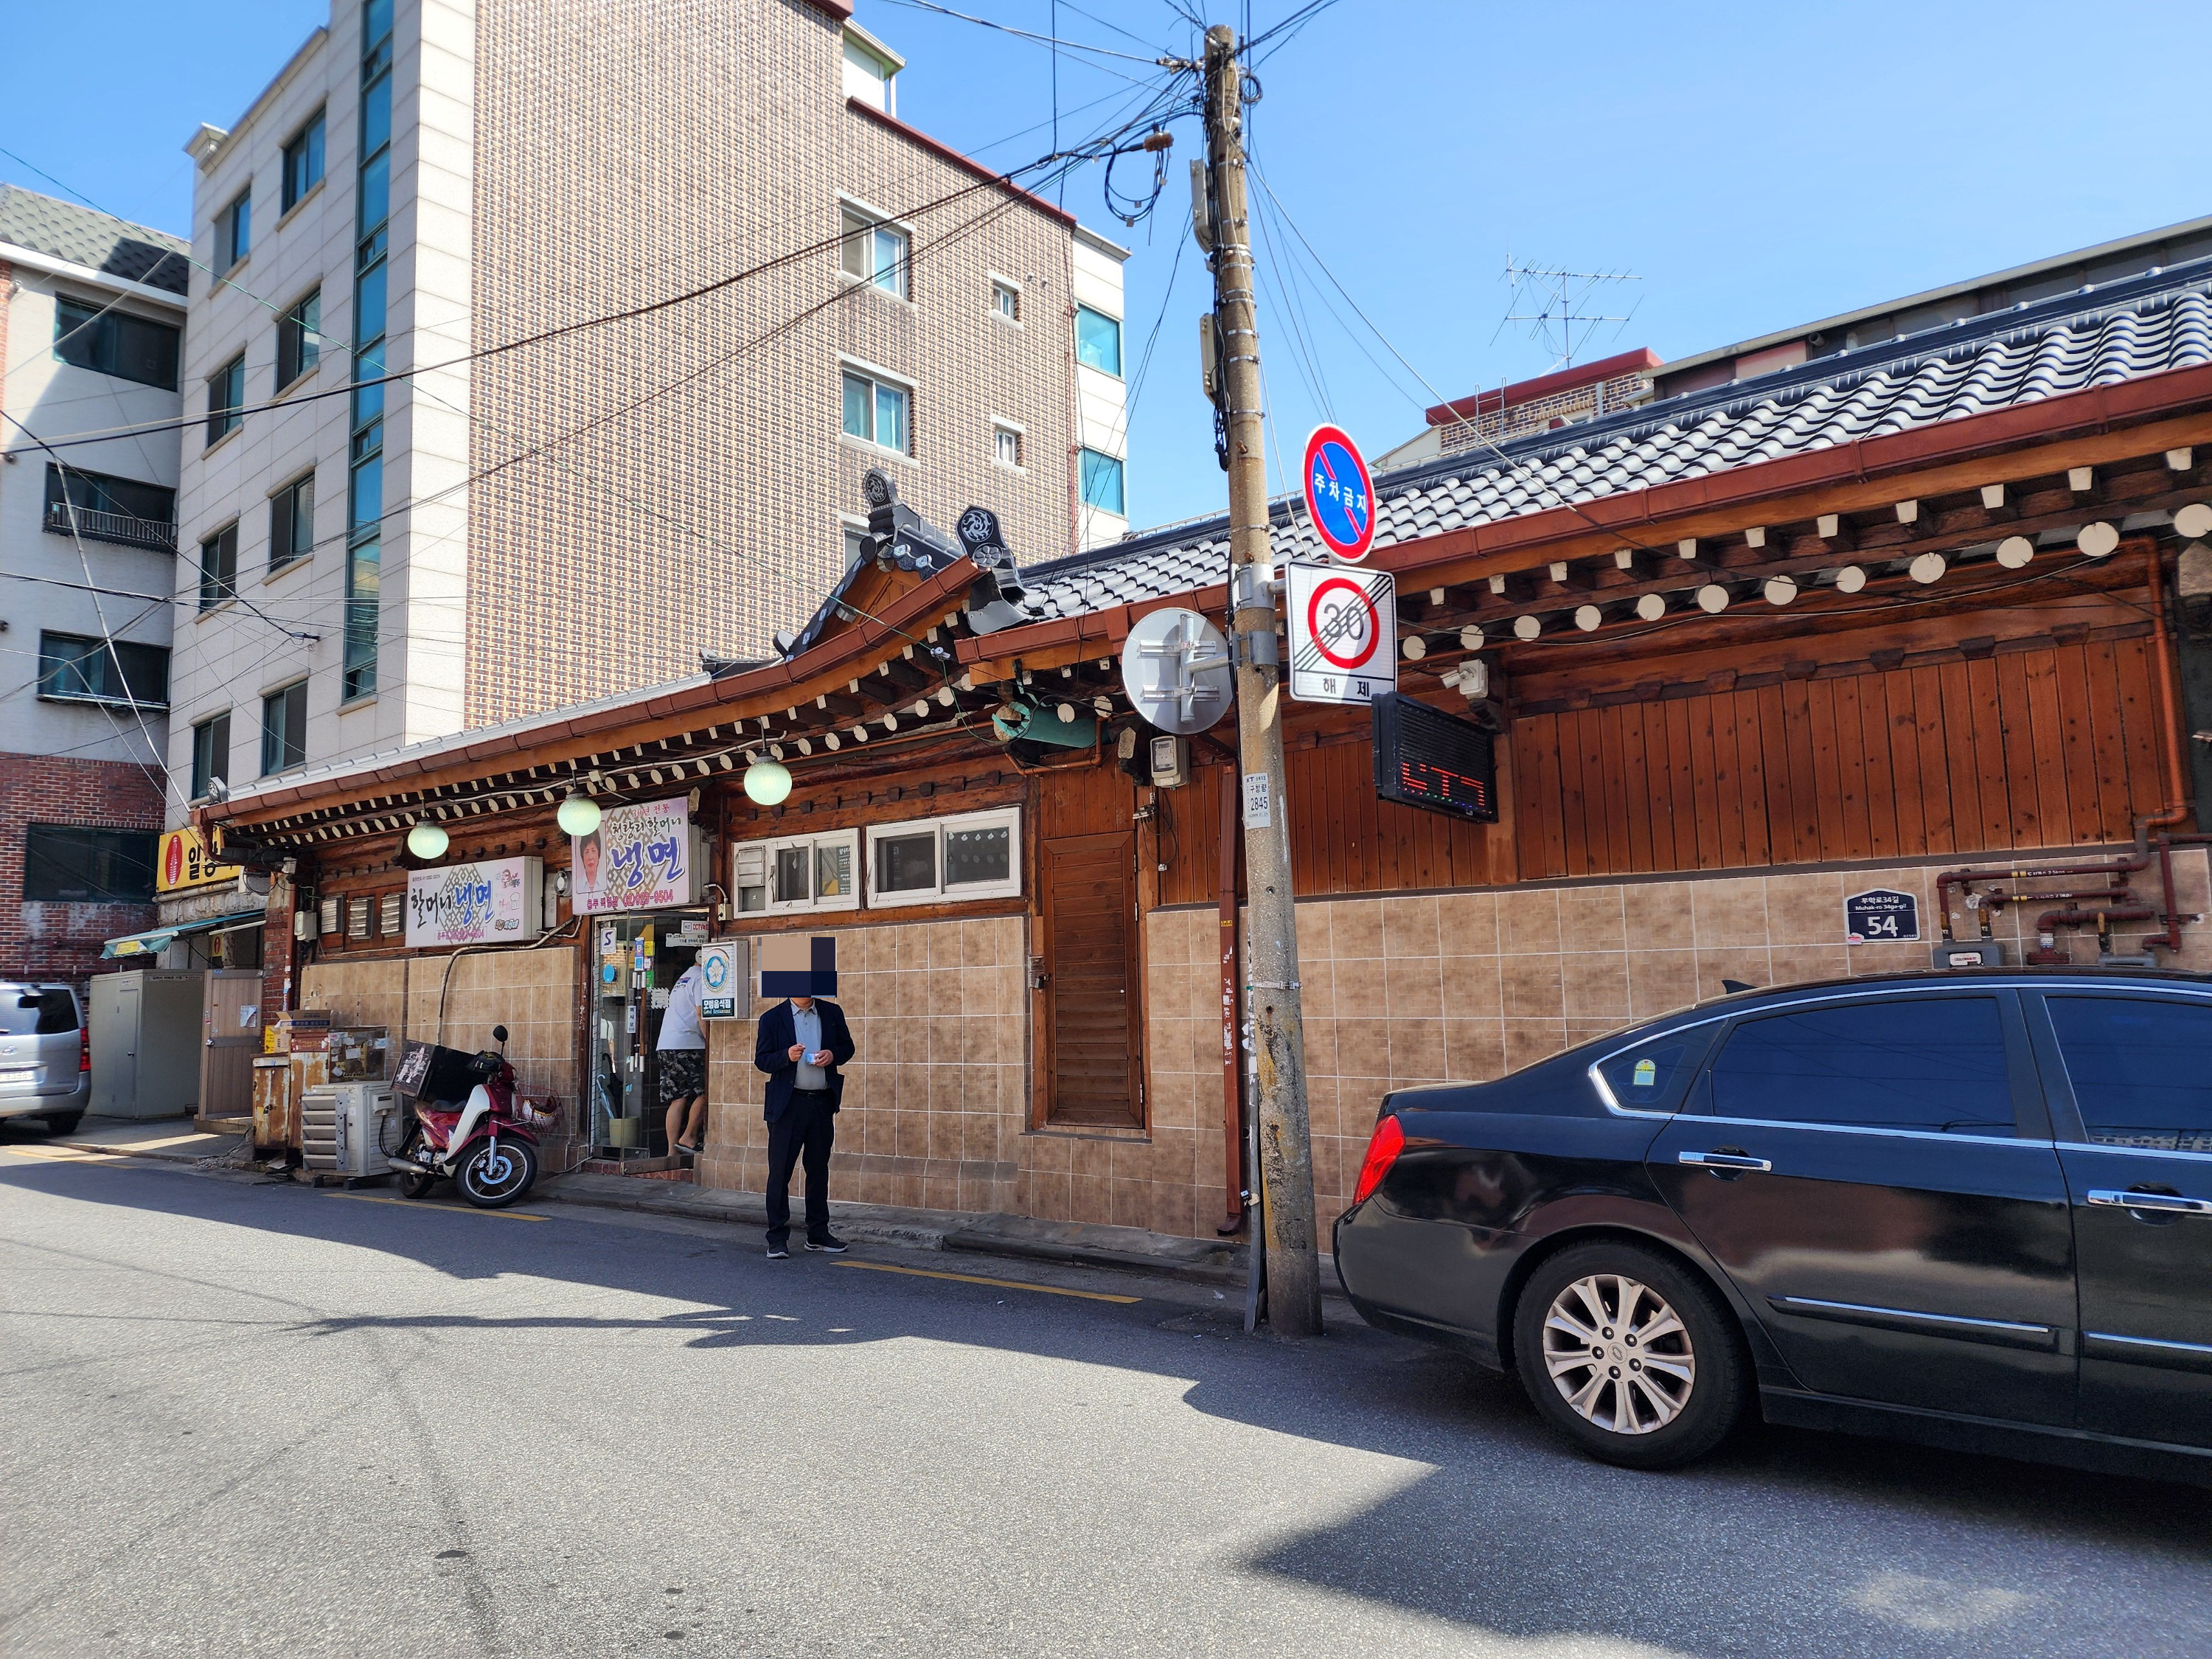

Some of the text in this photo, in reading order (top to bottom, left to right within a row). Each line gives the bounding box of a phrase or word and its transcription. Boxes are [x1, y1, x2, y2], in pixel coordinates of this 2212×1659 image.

[1314, 472, 1367, 515] 주차금지
[1324, 602, 1365, 641] 30
[632, 803, 670, 818] 30년 전통
[1251, 796, 1268, 811] 2845
[611, 816, 682, 841] 청량리 할머니
[611, 835, 684, 889] 냉면
[410, 887, 452, 930] 할머니
[453, 879, 495, 927] 냉면
[587, 898, 599, 911] 용두
[622, 888, 674, 907] 02)923-9504
[1867, 915, 1899, 936] 54
[703, 998, 731, 1009] 모범음식점
